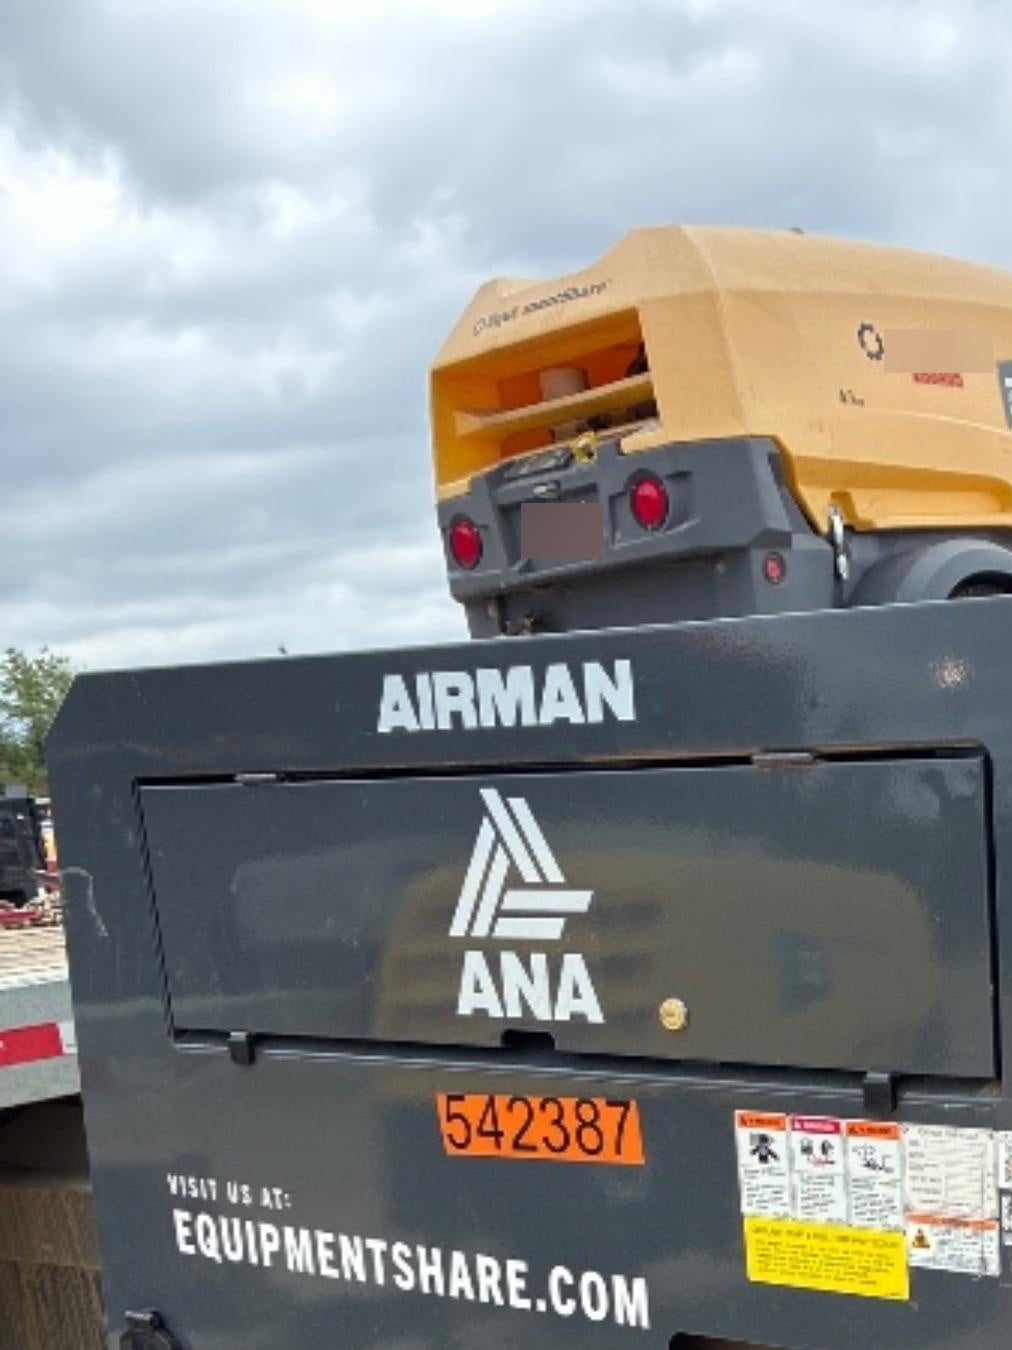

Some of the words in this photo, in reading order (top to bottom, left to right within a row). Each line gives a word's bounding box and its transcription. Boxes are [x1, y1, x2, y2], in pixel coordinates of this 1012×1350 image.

[377, 659, 636, 733] AIRMAN
[456, 950, 605, 1024] ANA
[445, 1094, 631, 1157] 542387
[166, 1172, 217, 1201] VISIT
[226, 1180, 252, 1206] US
[261, 1186, 292, 1210] AT:
[172, 1207, 652, 1330] EQUIPMENTSHARE.COM
